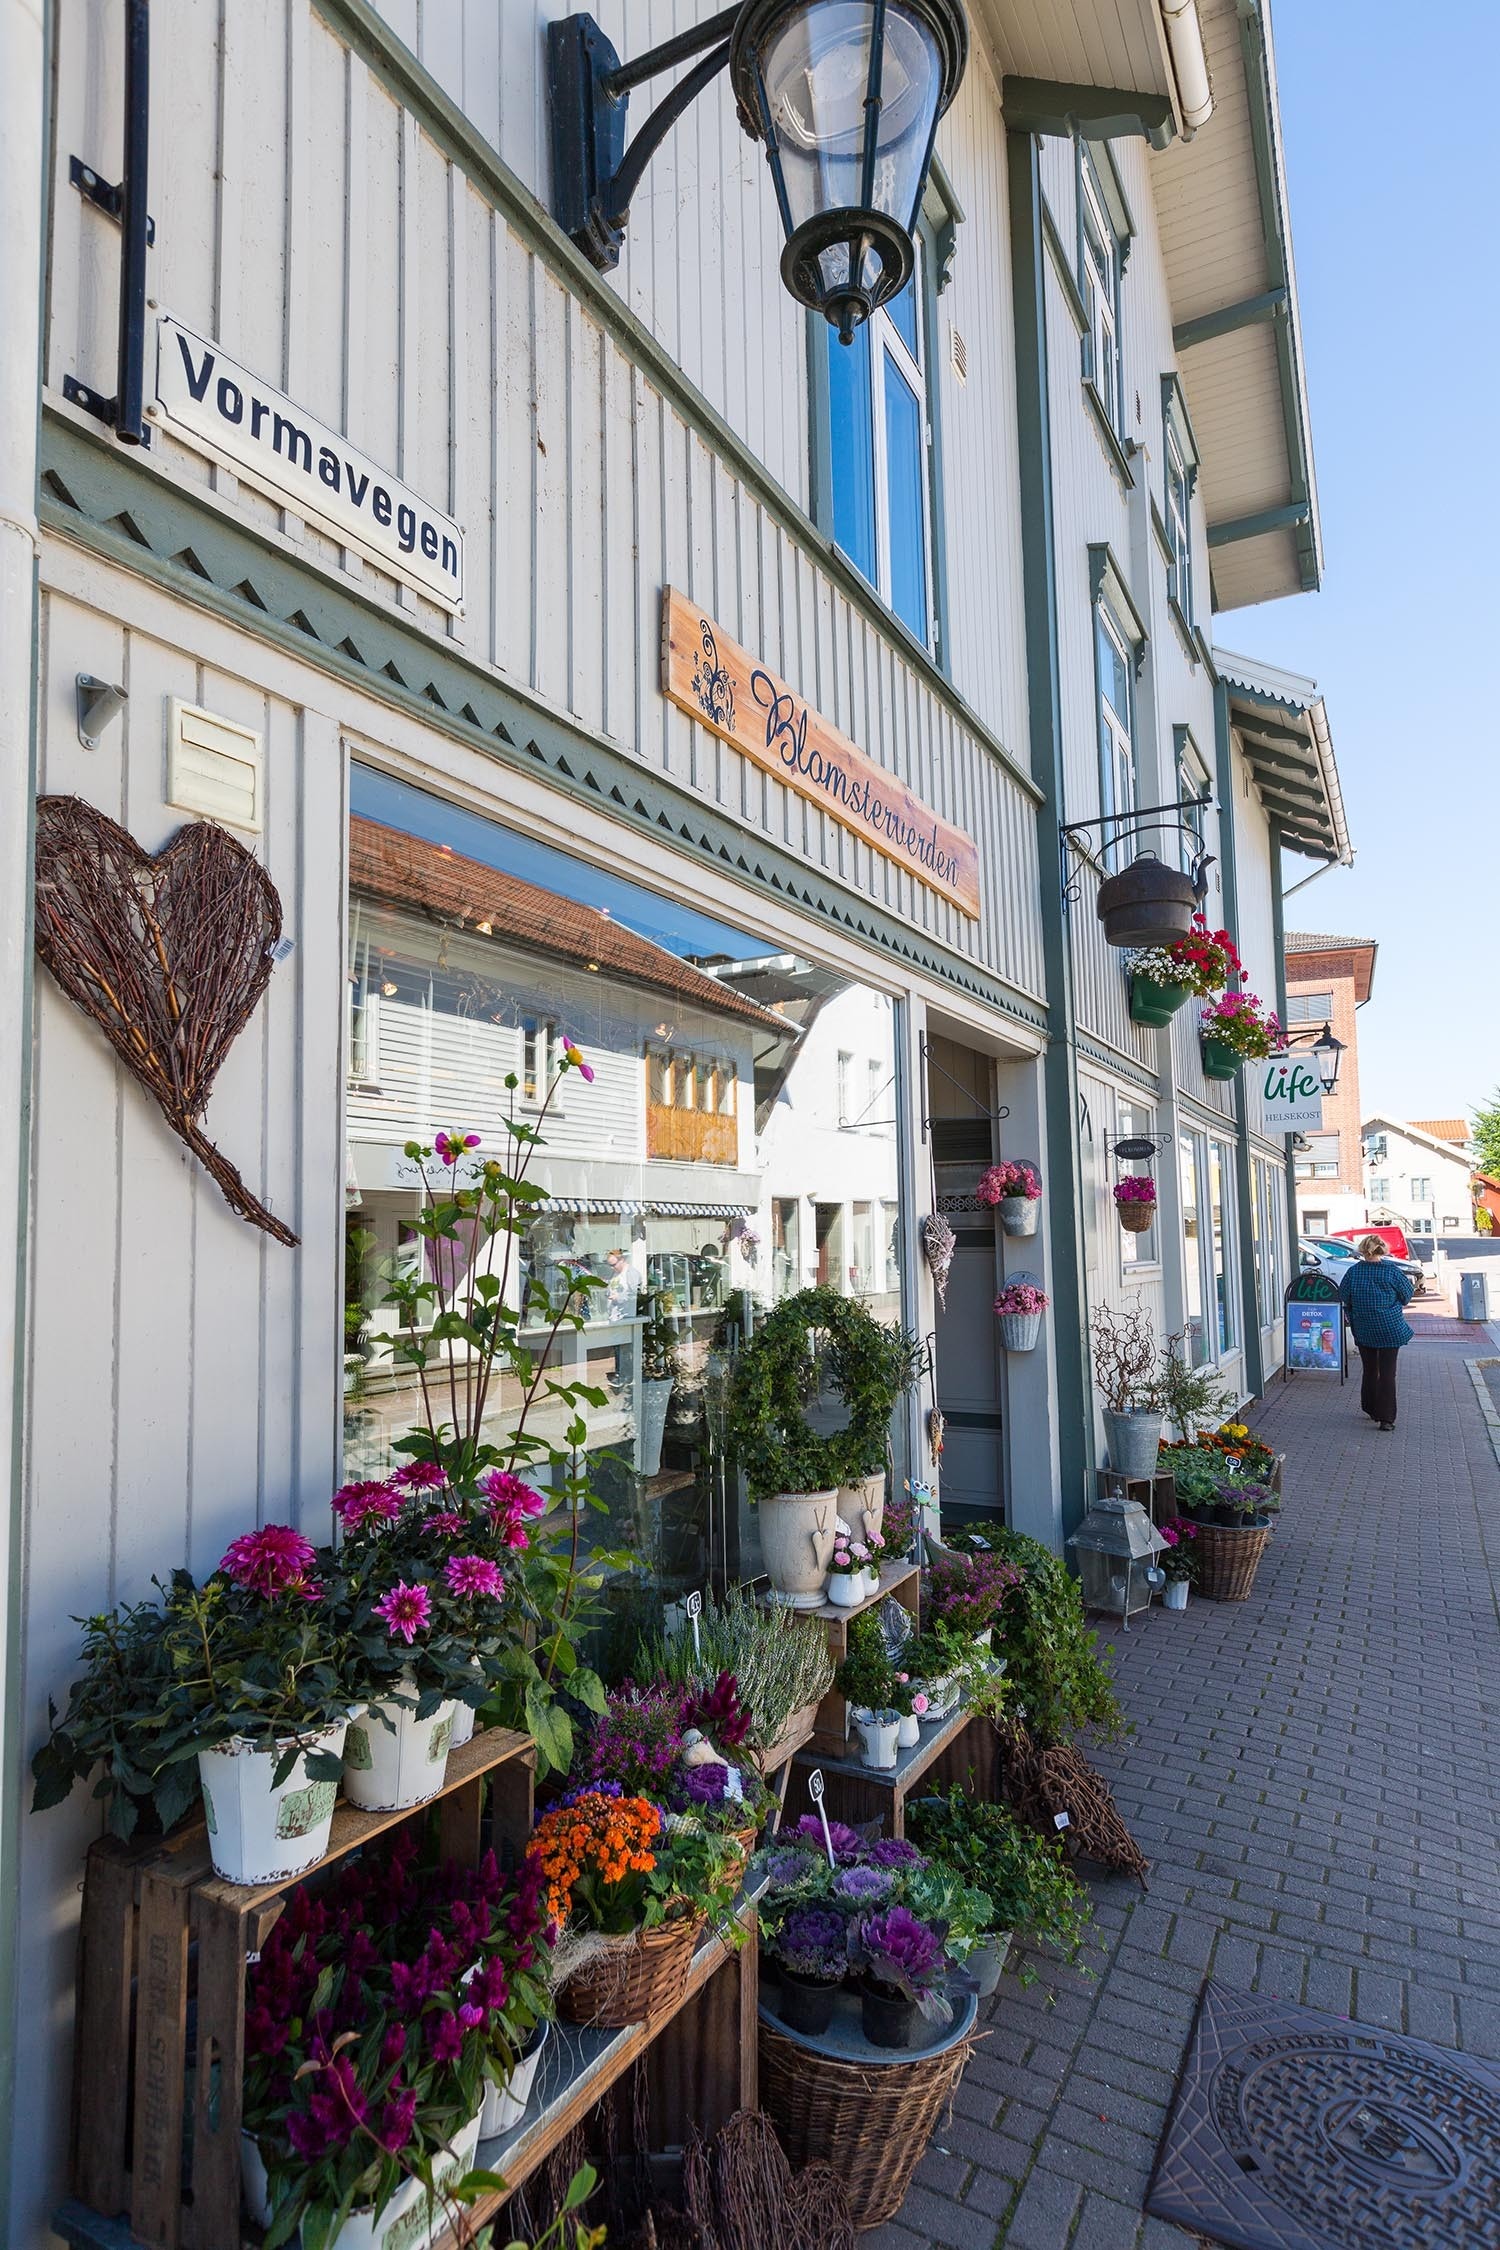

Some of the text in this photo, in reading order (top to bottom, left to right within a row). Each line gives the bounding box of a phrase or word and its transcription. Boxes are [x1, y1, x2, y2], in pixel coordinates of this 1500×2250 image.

[175, 332, 458, 579] Vormavegen
[750, 669, 959, 888] Blomsterverden
[1264, 1065, 1320, 1103] life
[1265, 1111, 1321, 1121] HELSEKOST
